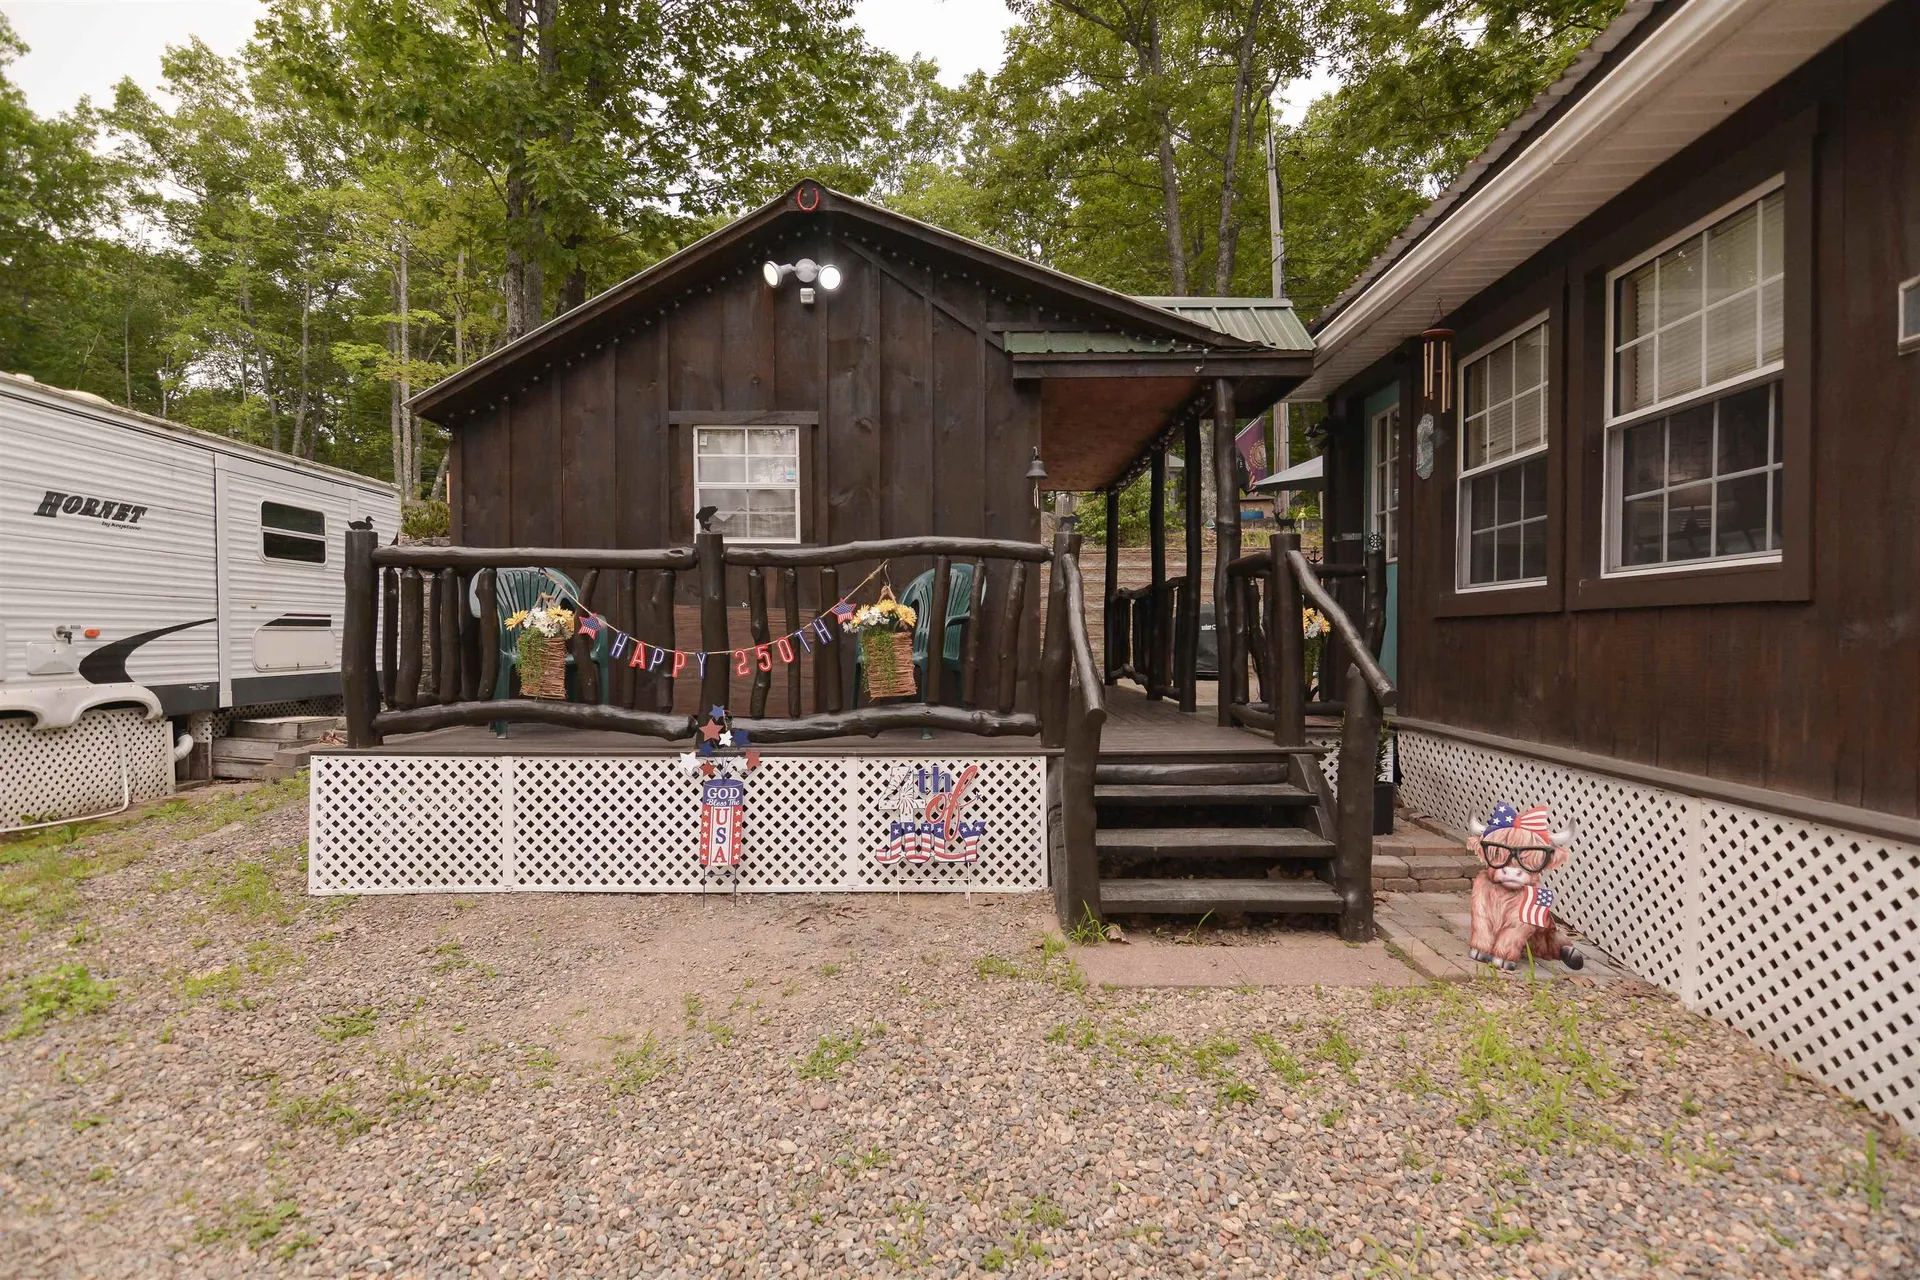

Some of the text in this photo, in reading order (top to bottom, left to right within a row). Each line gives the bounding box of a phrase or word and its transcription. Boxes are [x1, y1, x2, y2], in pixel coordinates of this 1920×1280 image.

[33, 490, 148, 523] HORNET
[609, 617, 833, 680] HAPPY 250TH
[706, 799, 728, 807] Bless
[707, 787, 740, 799] GOD
[878, 765, 979, 842] 4th of
[712, 808, 730, 863] USA
[875, 821, 986, 864] JULY
